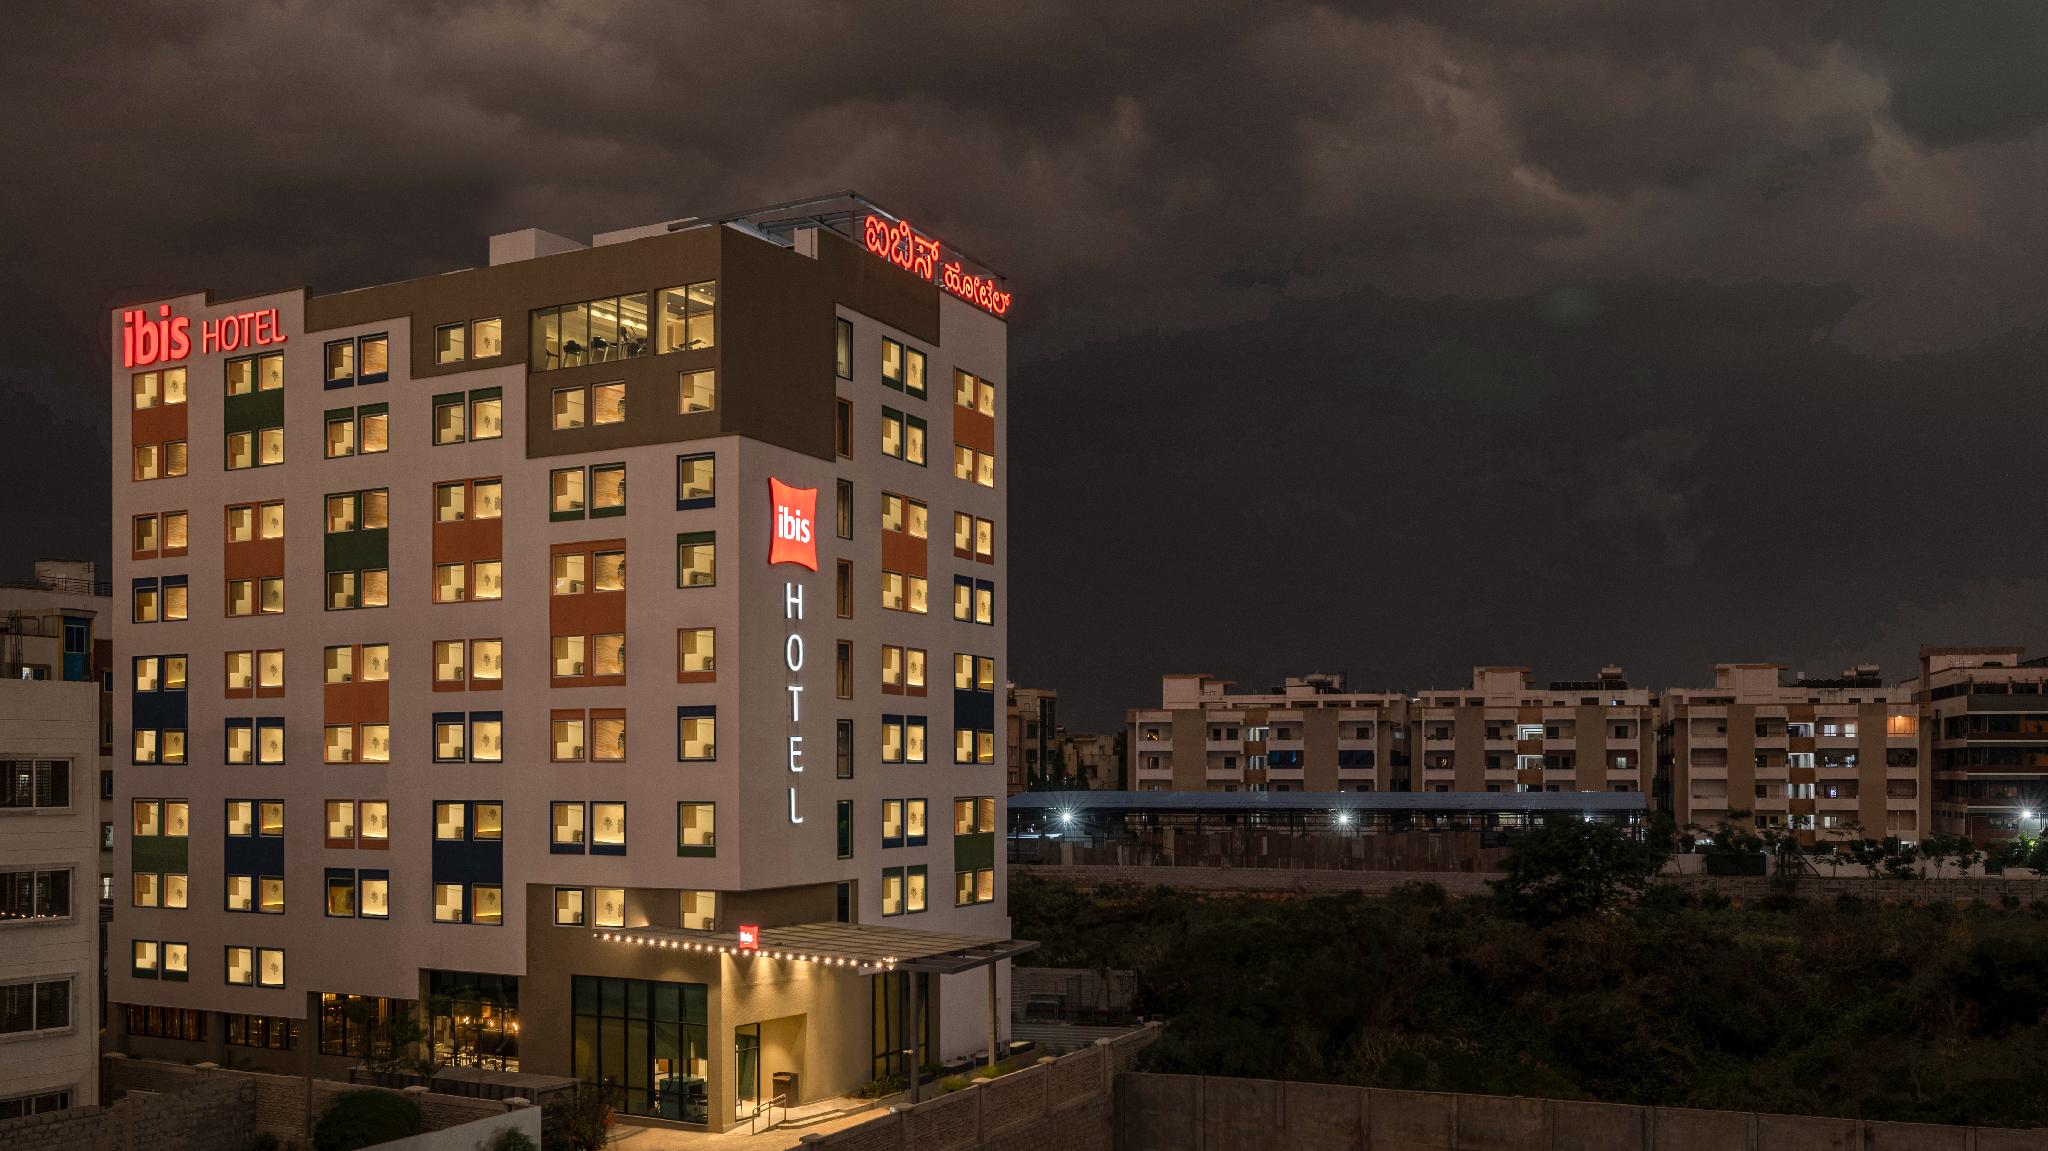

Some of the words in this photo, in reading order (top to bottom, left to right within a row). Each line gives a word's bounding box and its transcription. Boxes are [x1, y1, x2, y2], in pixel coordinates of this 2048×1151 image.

[124, 304, 190, 367] ibis
[202, 308, 288, 353] HOTEL
[778, 506, 810, 543] ibis
[785, 582, 803, 823] HOTEL
